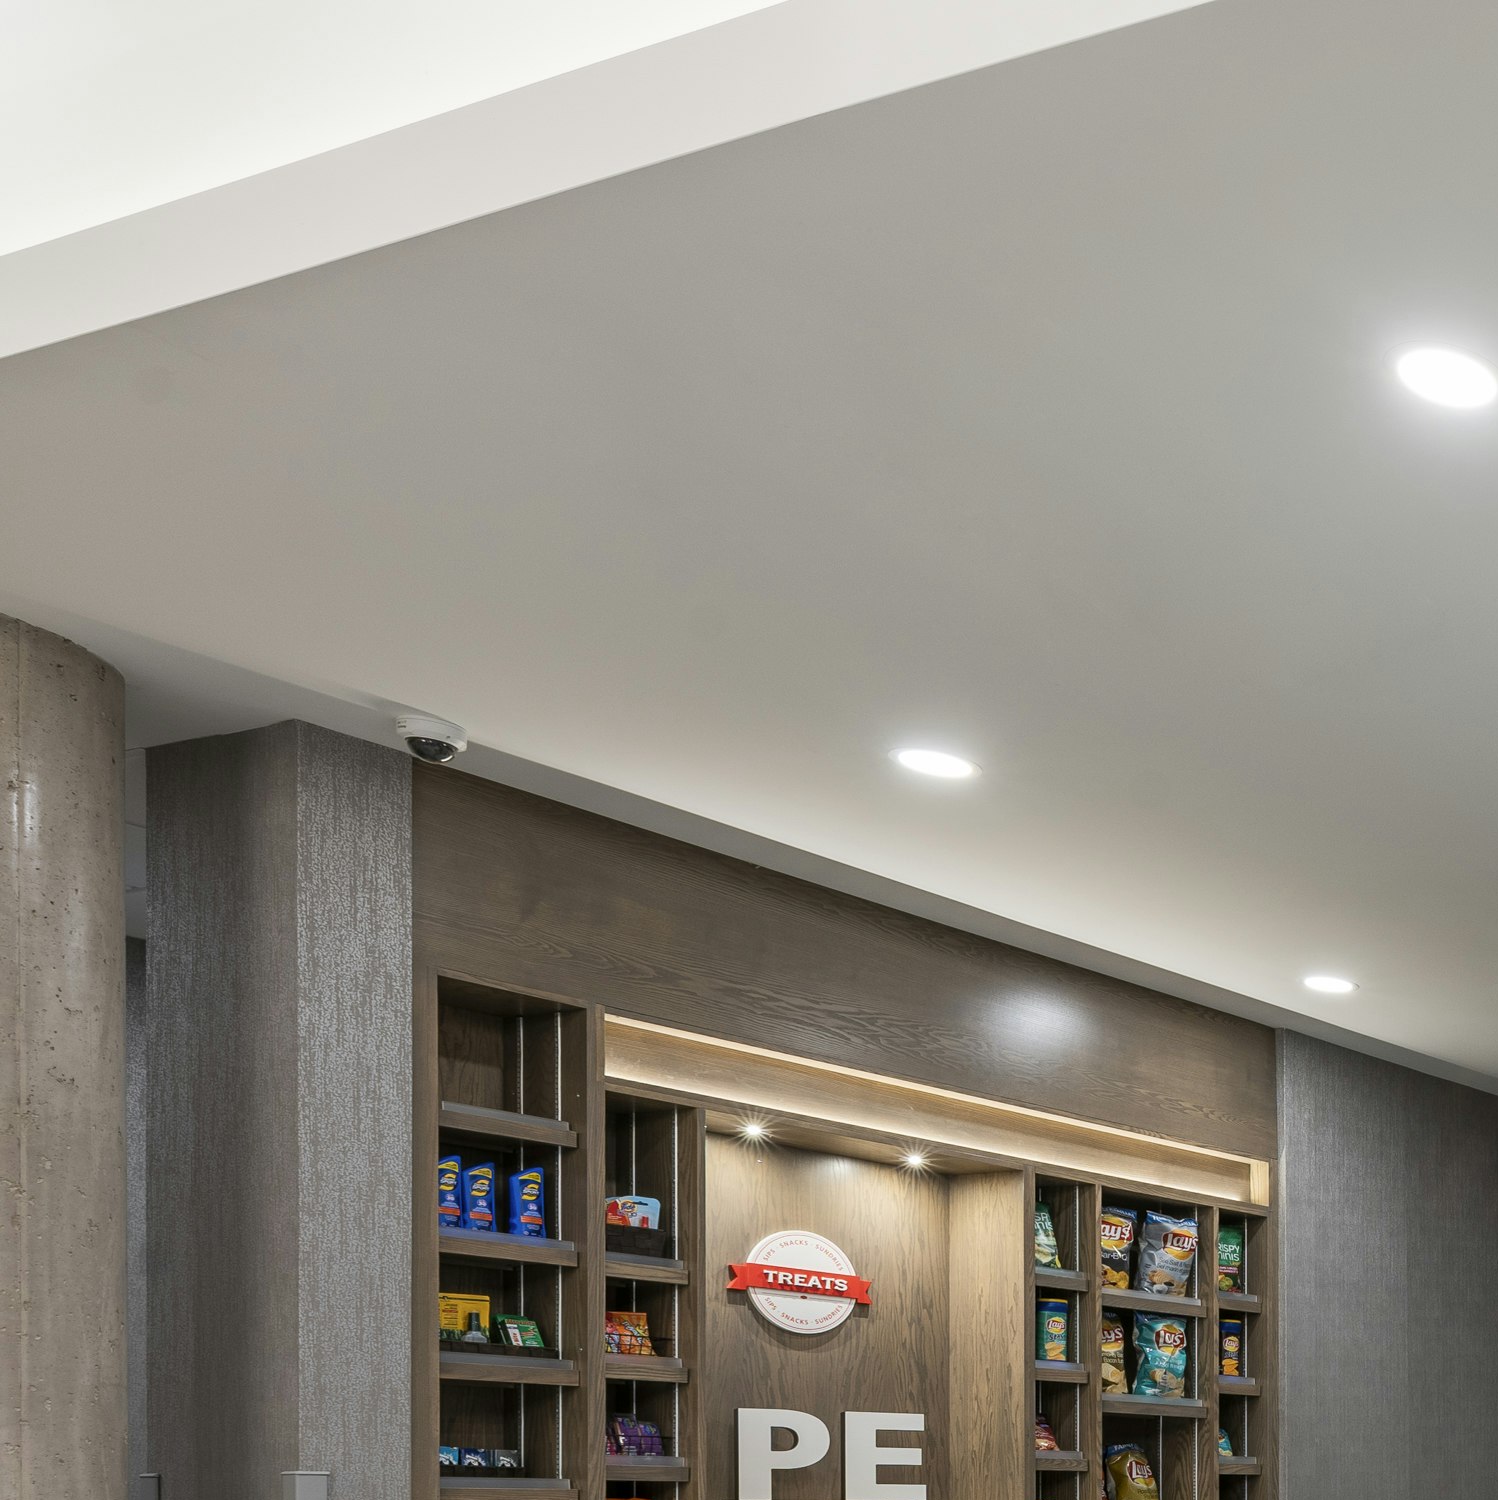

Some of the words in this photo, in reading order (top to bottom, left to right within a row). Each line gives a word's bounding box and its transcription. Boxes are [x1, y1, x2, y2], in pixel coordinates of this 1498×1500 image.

[763, 1248, 775, 1261] SIPS
[779, 1240, 809, 1249] SNACKS
[815, 1243, 844, 1271] SUNDRIES
[1218, 1242, 1240, 1253] RISPY
[762, 1269, 849, 1292] TREATS
[764, 1297, 777, 1311] SIPS
[781, 1312, 809, 1325] SNACKS
[815, 1304, 843, 1325] SUNDRIES
